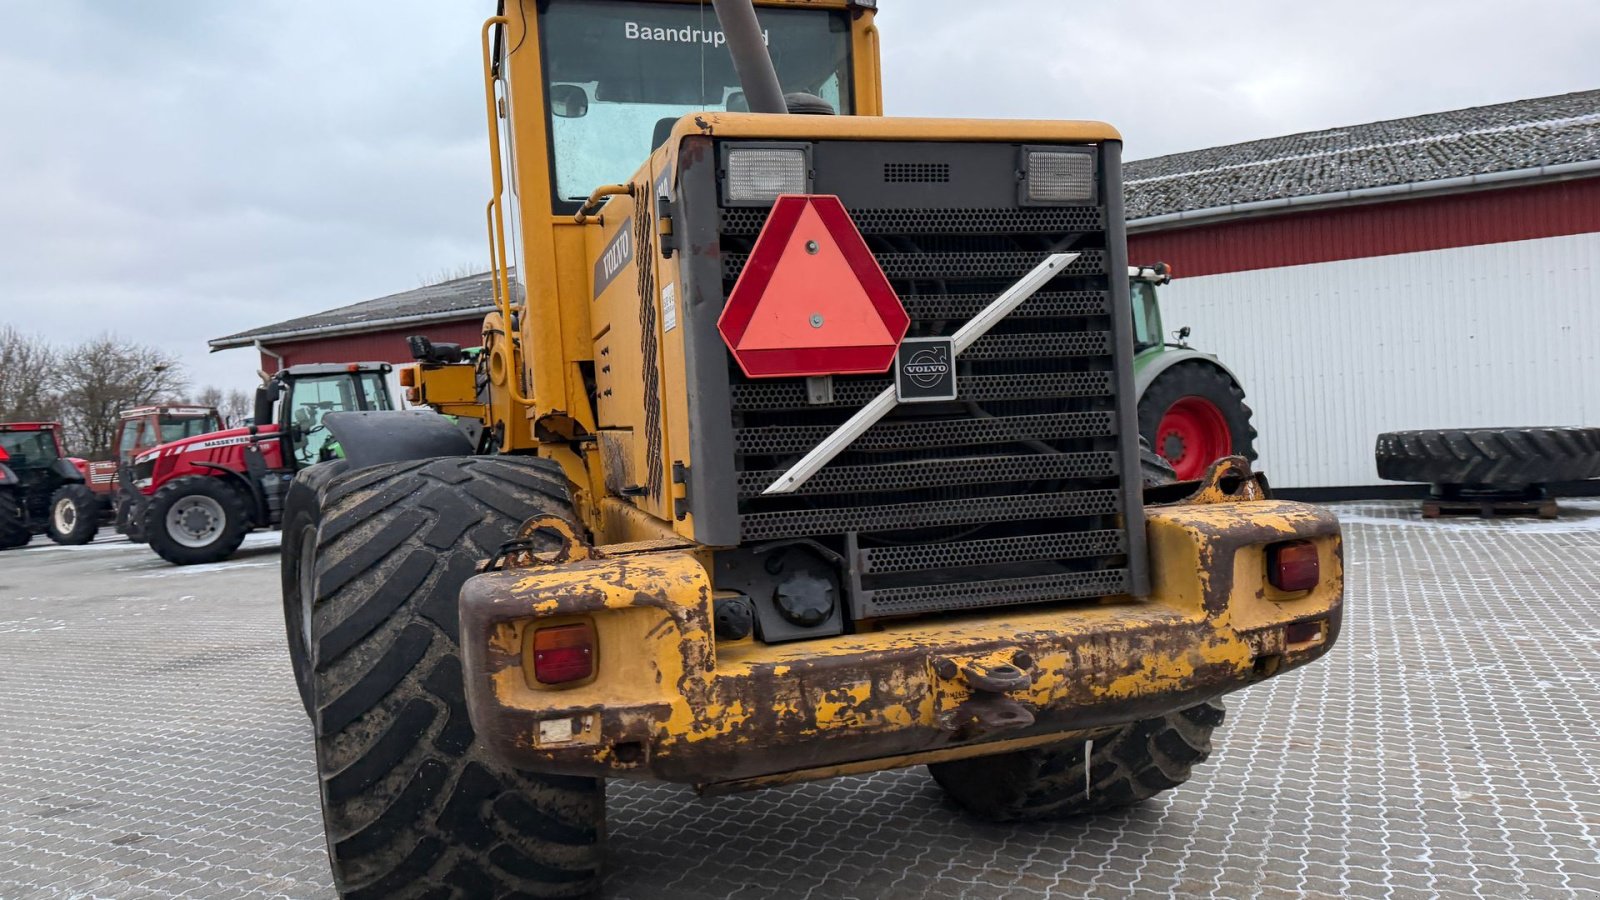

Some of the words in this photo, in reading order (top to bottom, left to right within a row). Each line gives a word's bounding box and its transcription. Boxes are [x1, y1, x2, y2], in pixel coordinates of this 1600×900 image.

[603, 230, 629, 280] VOLVO
[906, 365, 946, 373] VOLVO
[204, 438, 235, 447] MASSEY
